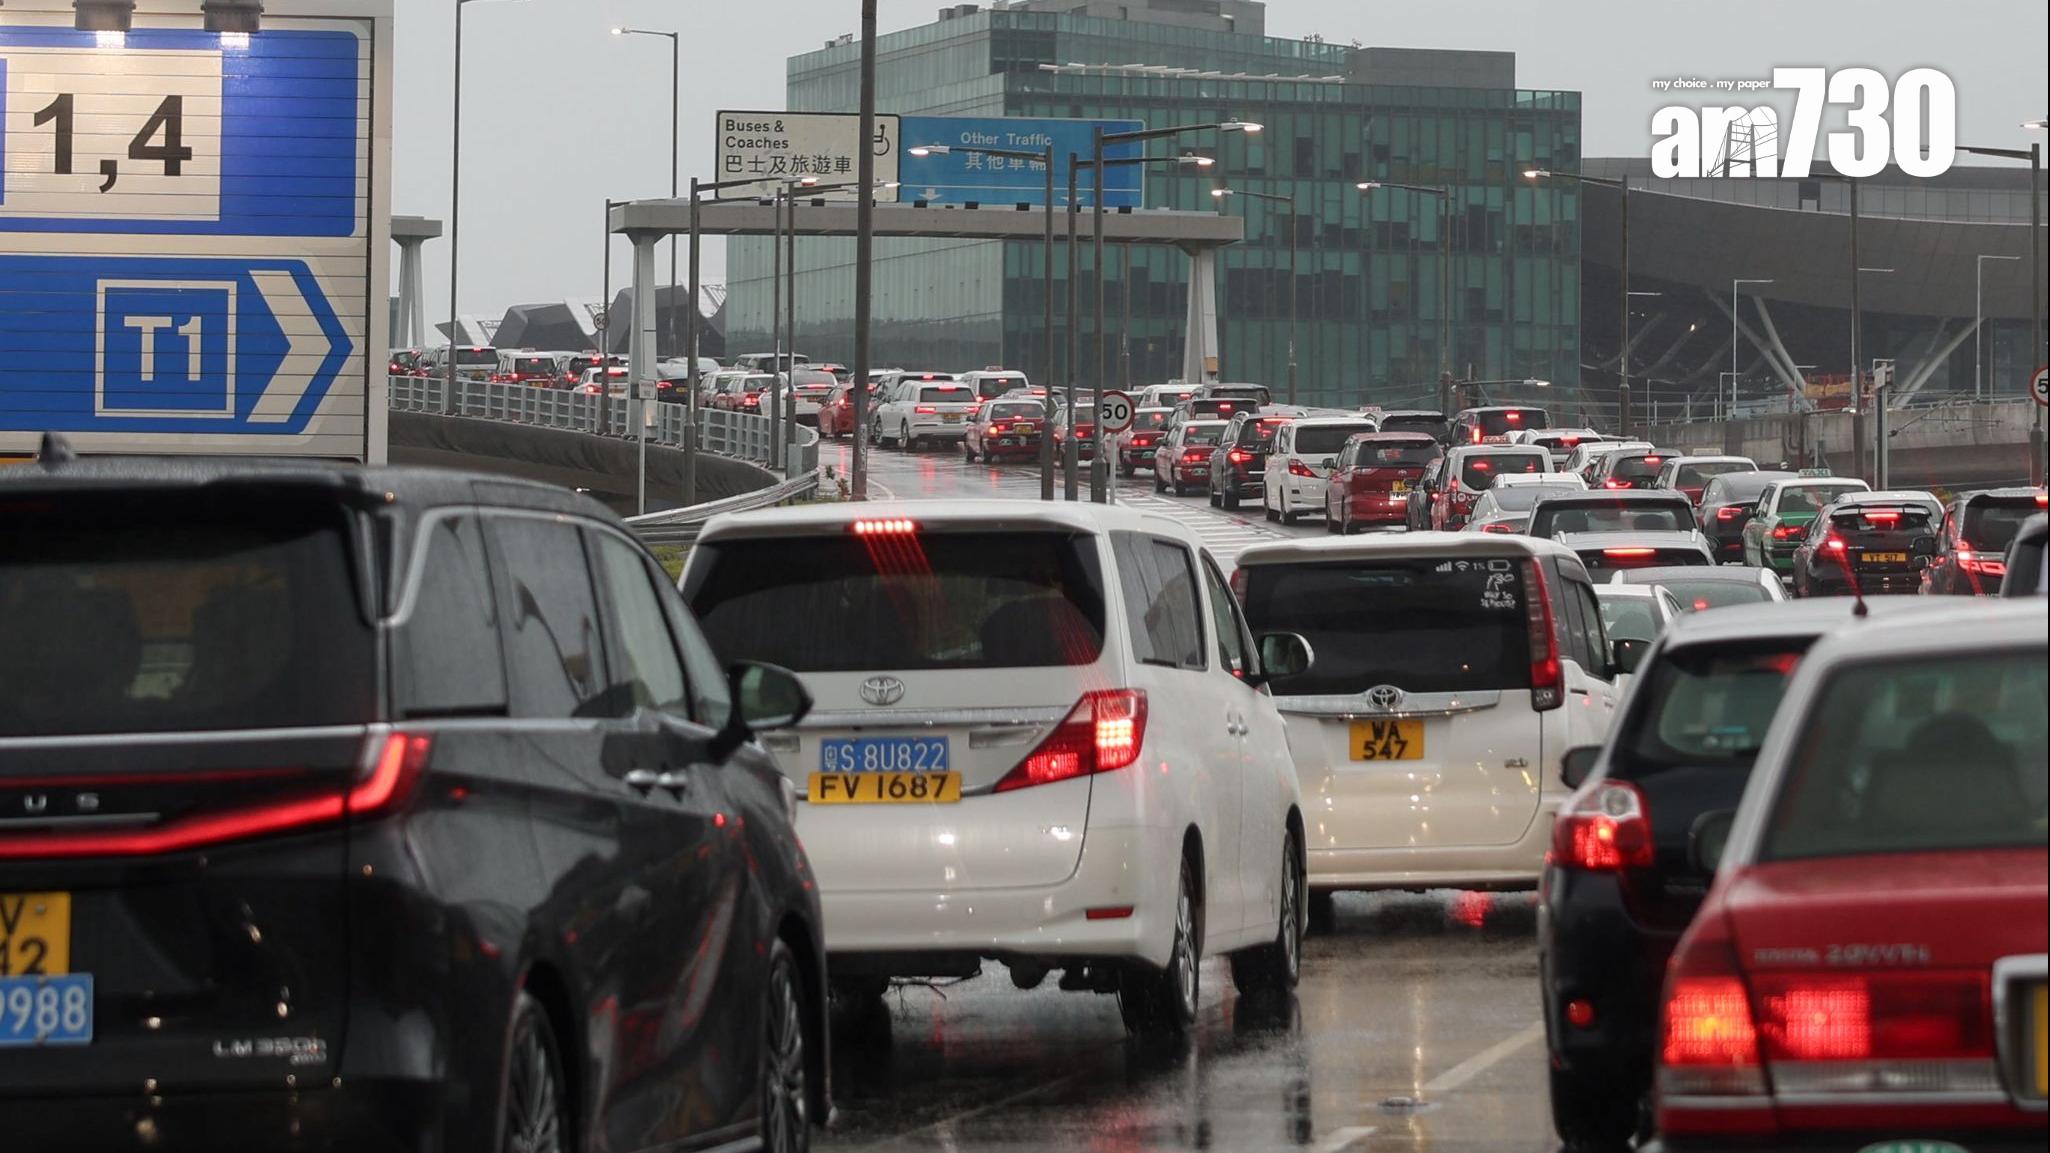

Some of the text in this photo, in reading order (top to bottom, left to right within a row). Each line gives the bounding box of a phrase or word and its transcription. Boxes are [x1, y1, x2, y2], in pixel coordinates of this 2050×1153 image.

[726, 119, 785, 133] Buses &
[33, 93, 193, 194] 1,4
[725, 136, 789, 149] Coaches
[960, 131, 1053, 146] Other Traffic
[725, 154, 852, 175] 巴士及旅遊車
[123, 315, 202, 381] T1
[1102, 403, 1128, 420] 50
[1372, 720, 1401, 741] WA
[1363, 740, 1408, 760] 547
[820, 774, 948, 799] FV 1687
